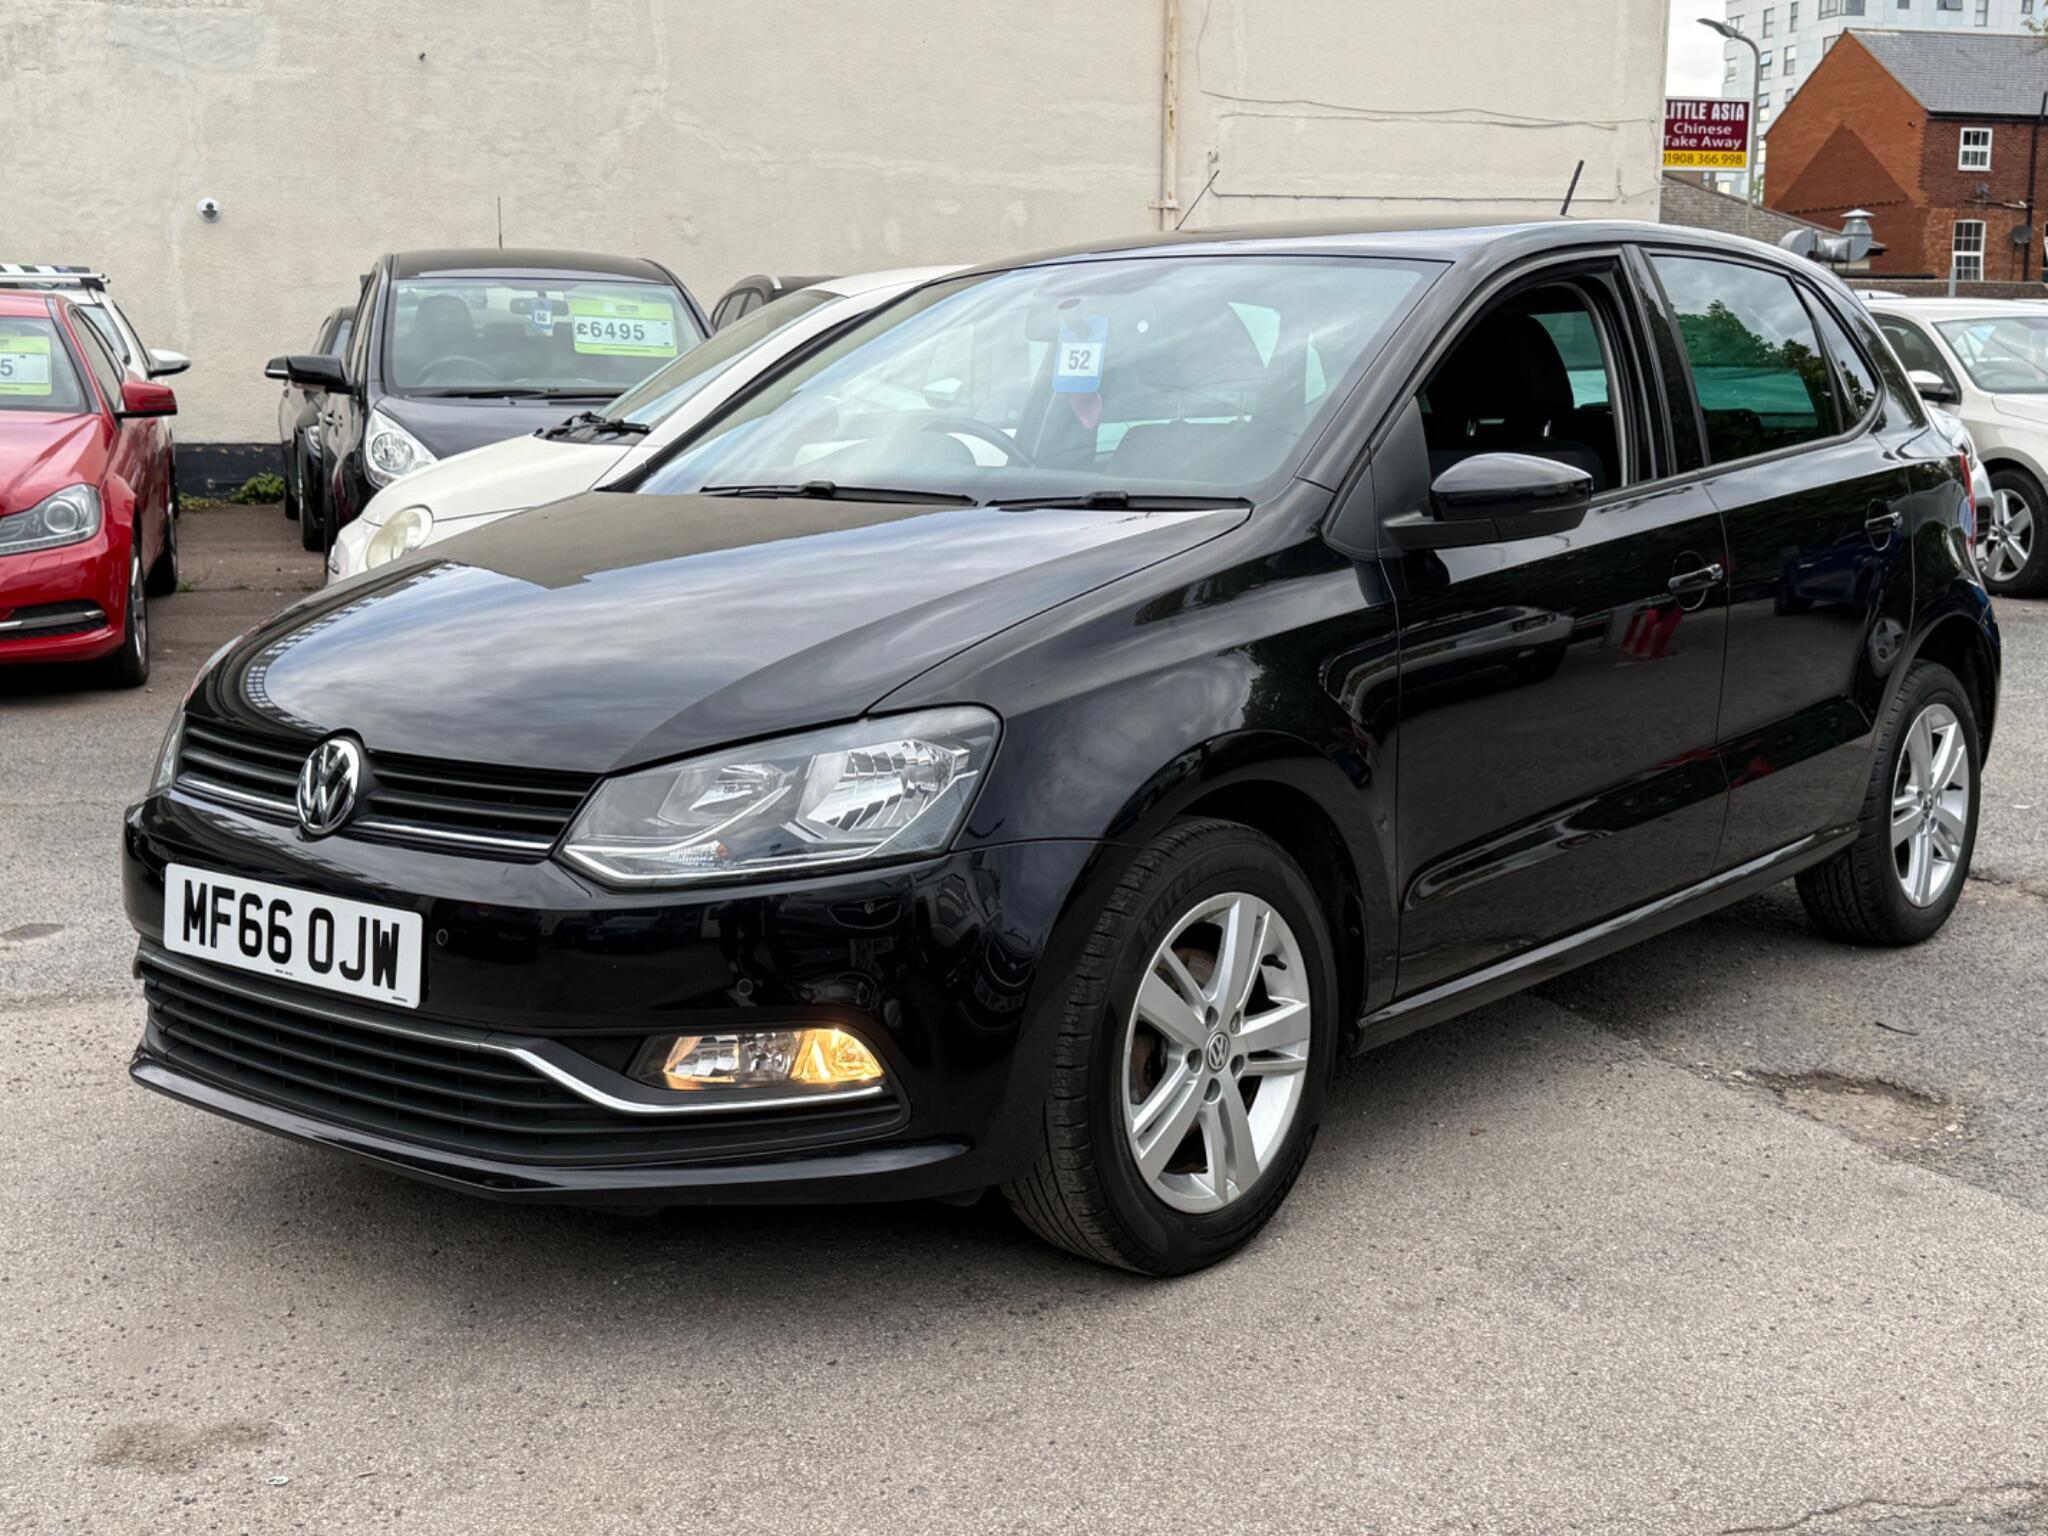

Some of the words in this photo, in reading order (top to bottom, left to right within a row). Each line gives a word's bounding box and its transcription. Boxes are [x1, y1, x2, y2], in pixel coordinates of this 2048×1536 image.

[1665, 102, 1707, 120] LITTLE
[1711, 103, 1745, 121] ASIA
[1673, 122, 1732, 135] Chinese
[1664, 135, 1697, 147] Take
[1701, 136, 1742, 150] Away
[1698, 153, 1719, 165] 366
[1721, 154, 1743, 165] 998
[576, 321, 645, 341] £6495
[1068, 349, 1091, 370] 52
[183, 879, 293, 965] MF66
[308, 906, 400, 990] OJW
